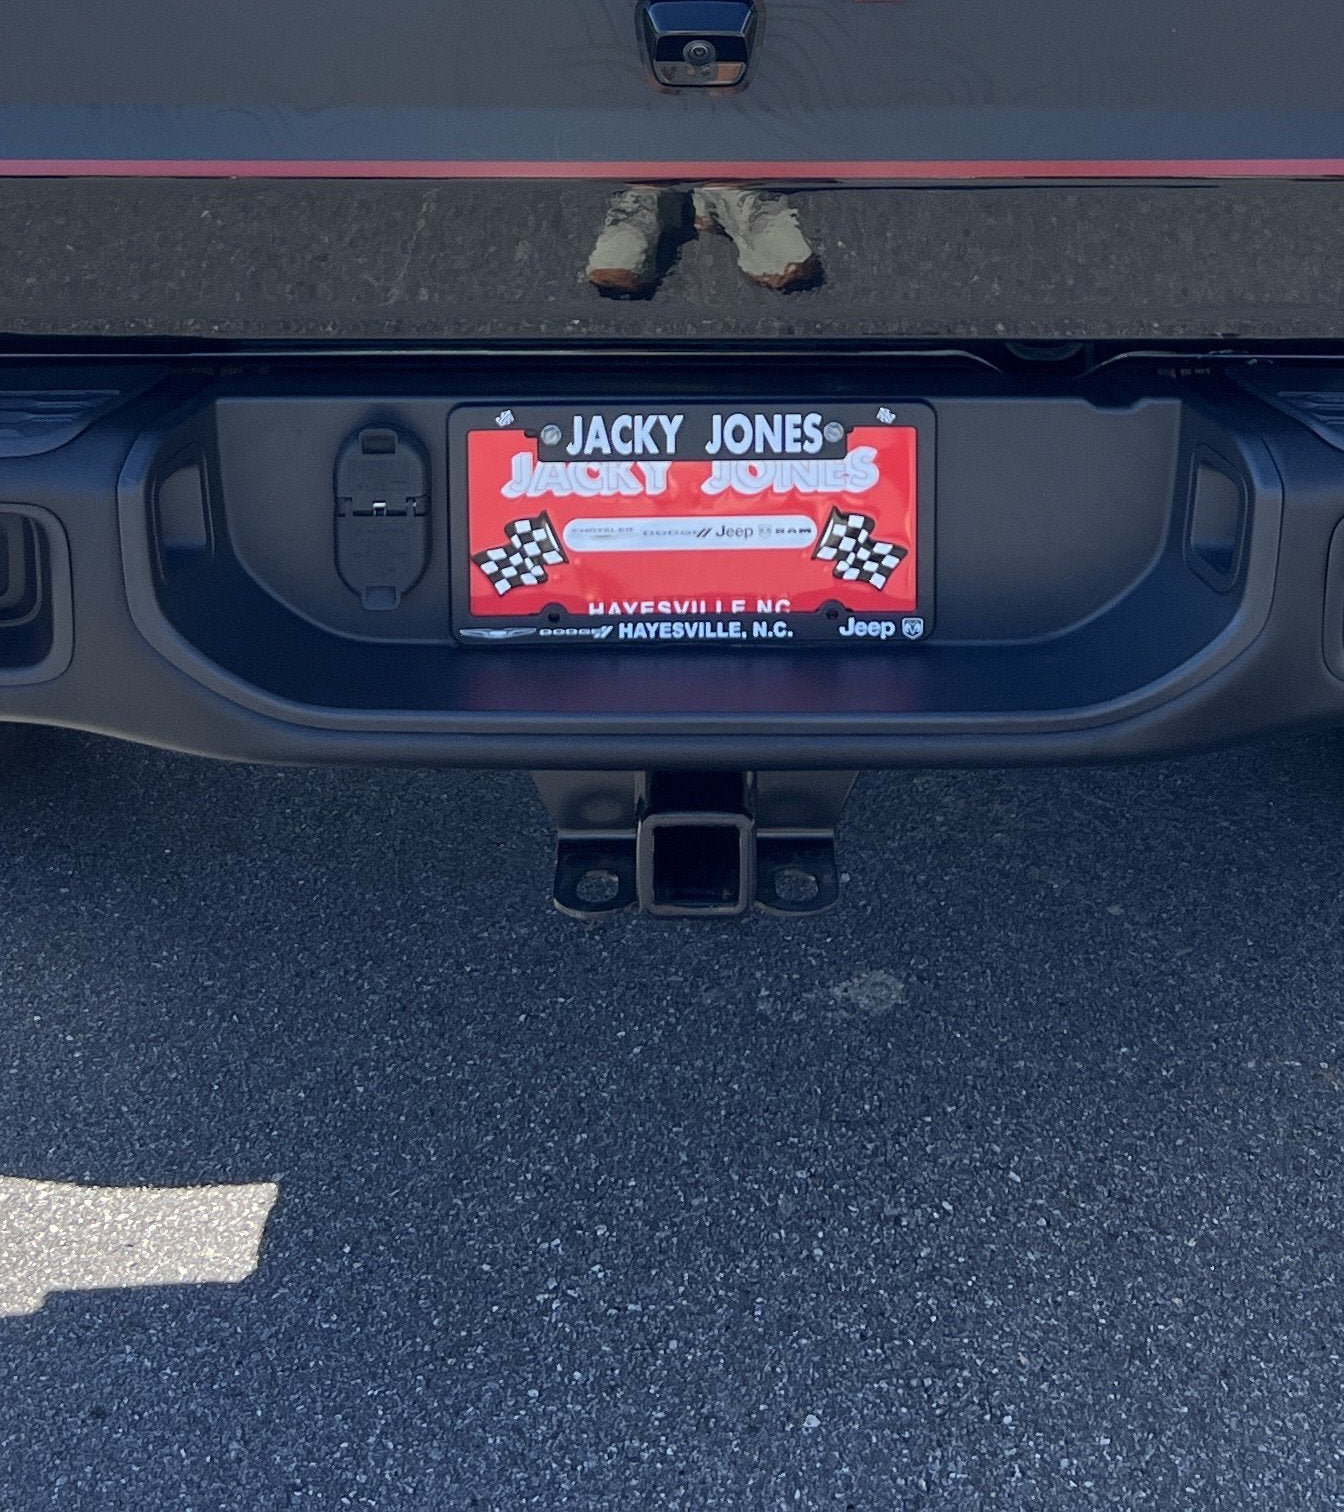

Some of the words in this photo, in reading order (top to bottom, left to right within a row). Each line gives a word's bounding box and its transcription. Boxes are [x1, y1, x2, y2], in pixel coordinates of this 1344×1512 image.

[566, 414, 684, 455] JACKY
[705, 412, 824, 455] JONES
[715, 524, 754, 538] Jeep
[618, 621, 747, 639] HAYESVILLE,
[753, 621, 794, 638] N.C.
[839, 618, 895, 638] Jeep
